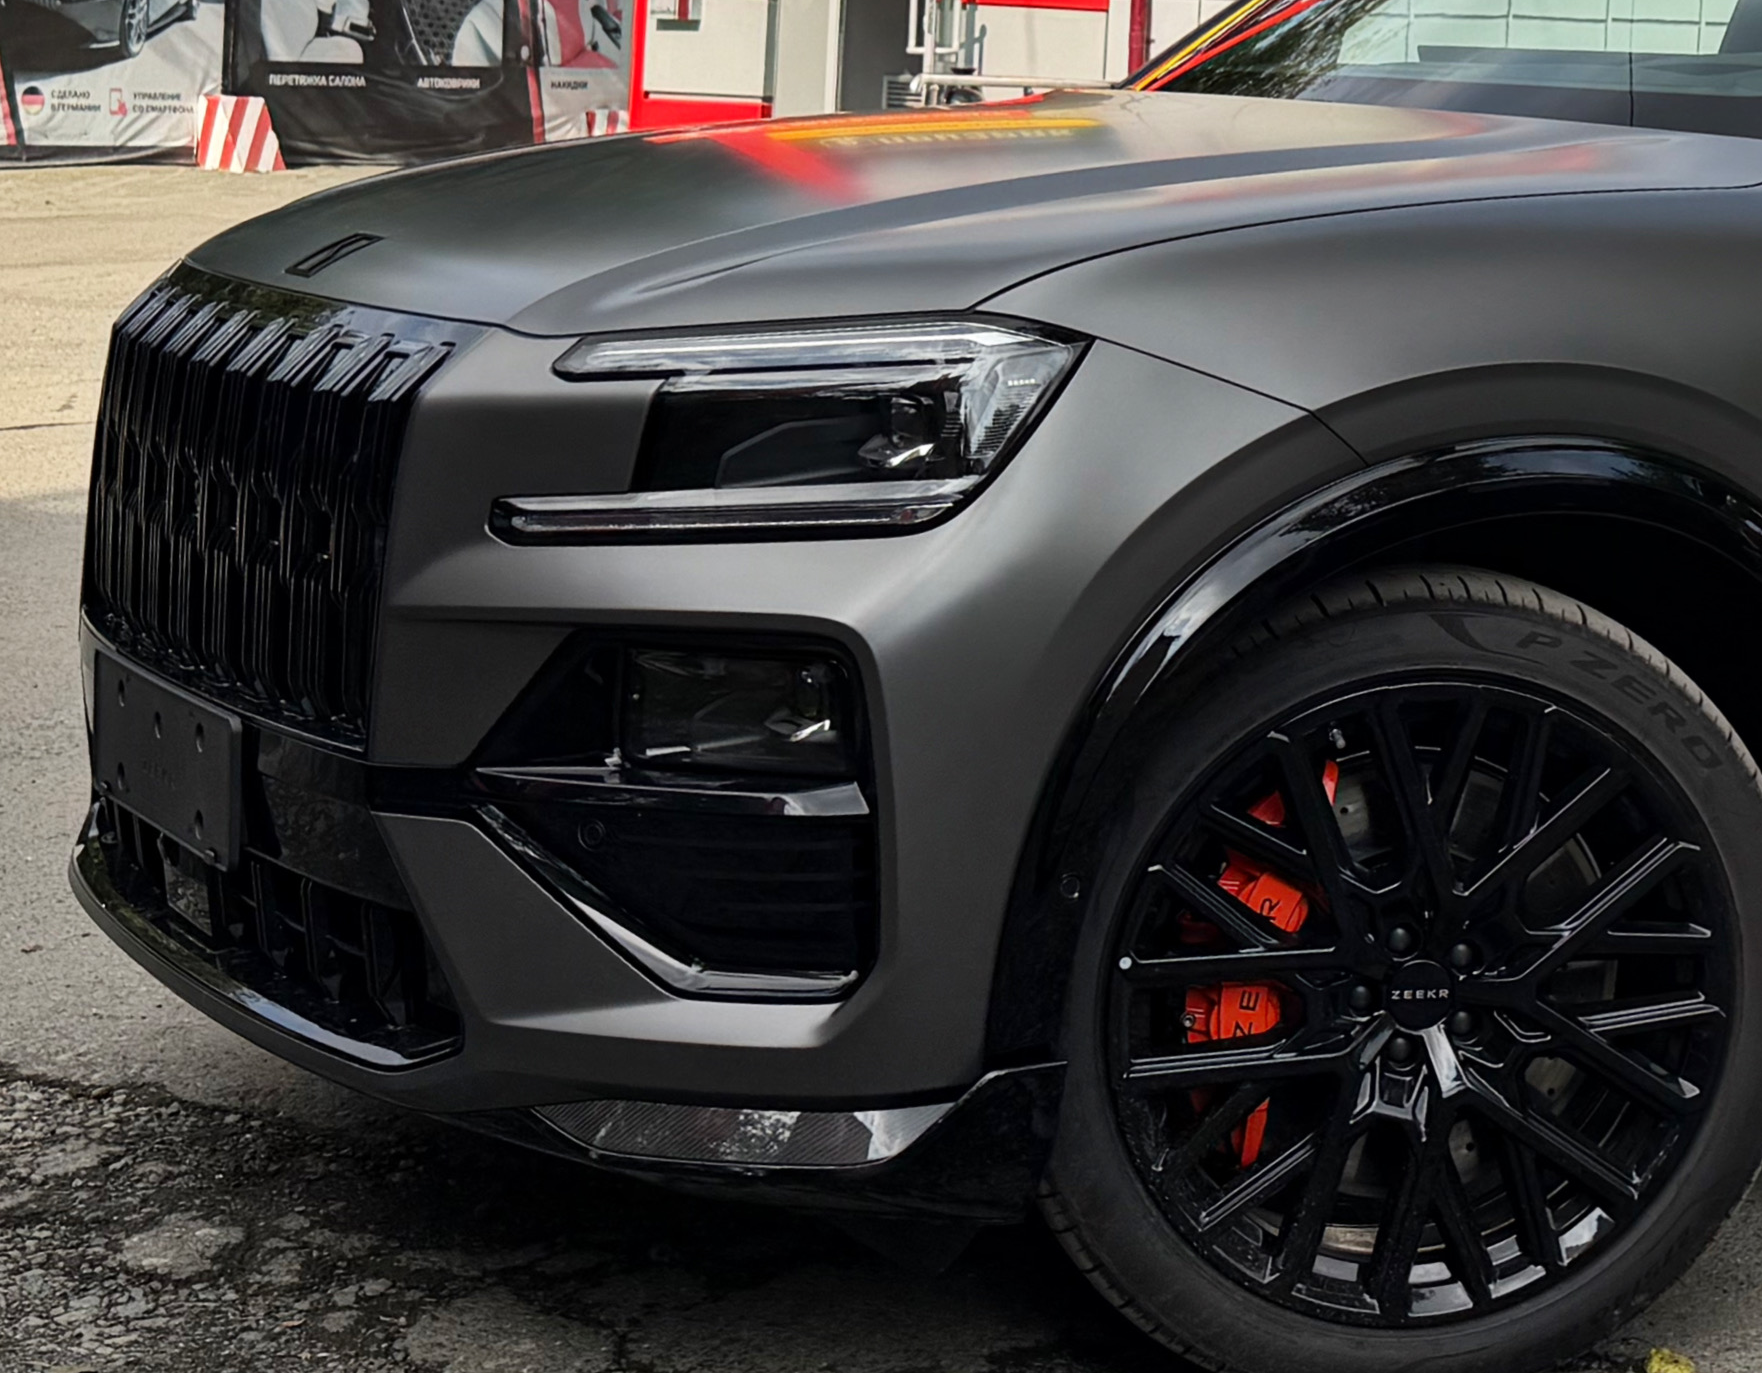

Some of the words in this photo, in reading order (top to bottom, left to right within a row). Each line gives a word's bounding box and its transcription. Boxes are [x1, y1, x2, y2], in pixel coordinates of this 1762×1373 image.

[328, 74, 366, 89] САЛОНА
[417, 77, 481, 90] АВТОКОВРИКИ
[550, 80, 588, 90] НАКИДКИ
[1516, 630, 1562, 649] P
[1568, 650, 1724, 769] ZERO
[1391, 989, 1449, 1000] ZEEKR
